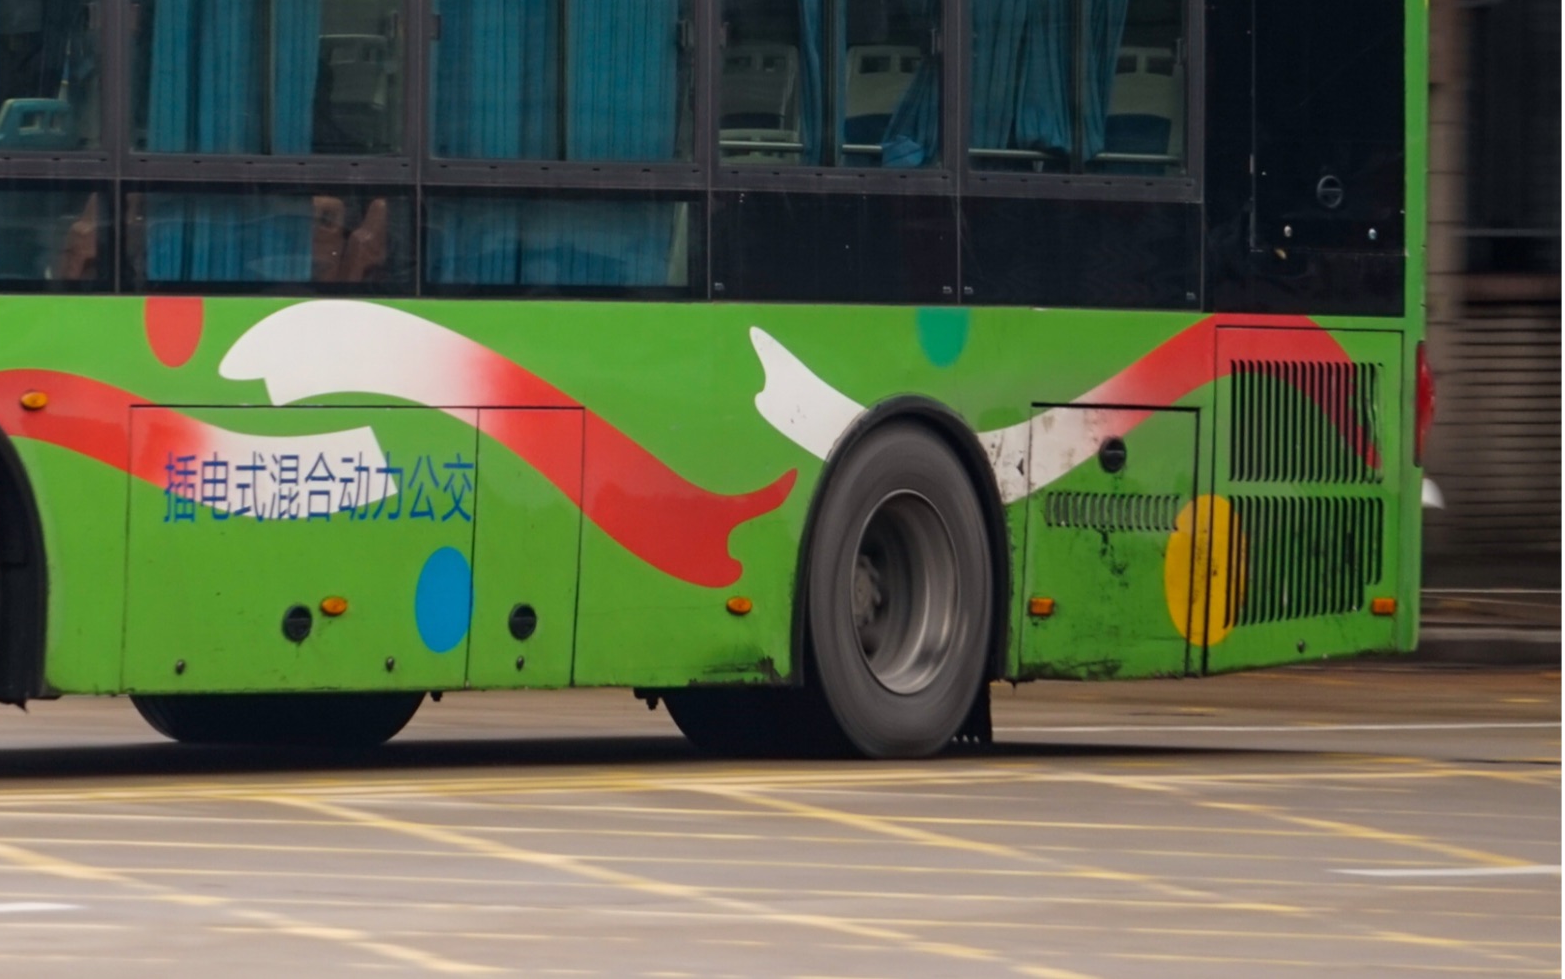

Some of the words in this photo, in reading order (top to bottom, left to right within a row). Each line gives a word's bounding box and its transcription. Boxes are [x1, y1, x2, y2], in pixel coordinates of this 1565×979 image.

[164, 451, 474, 522] 插电式混合动力公交
